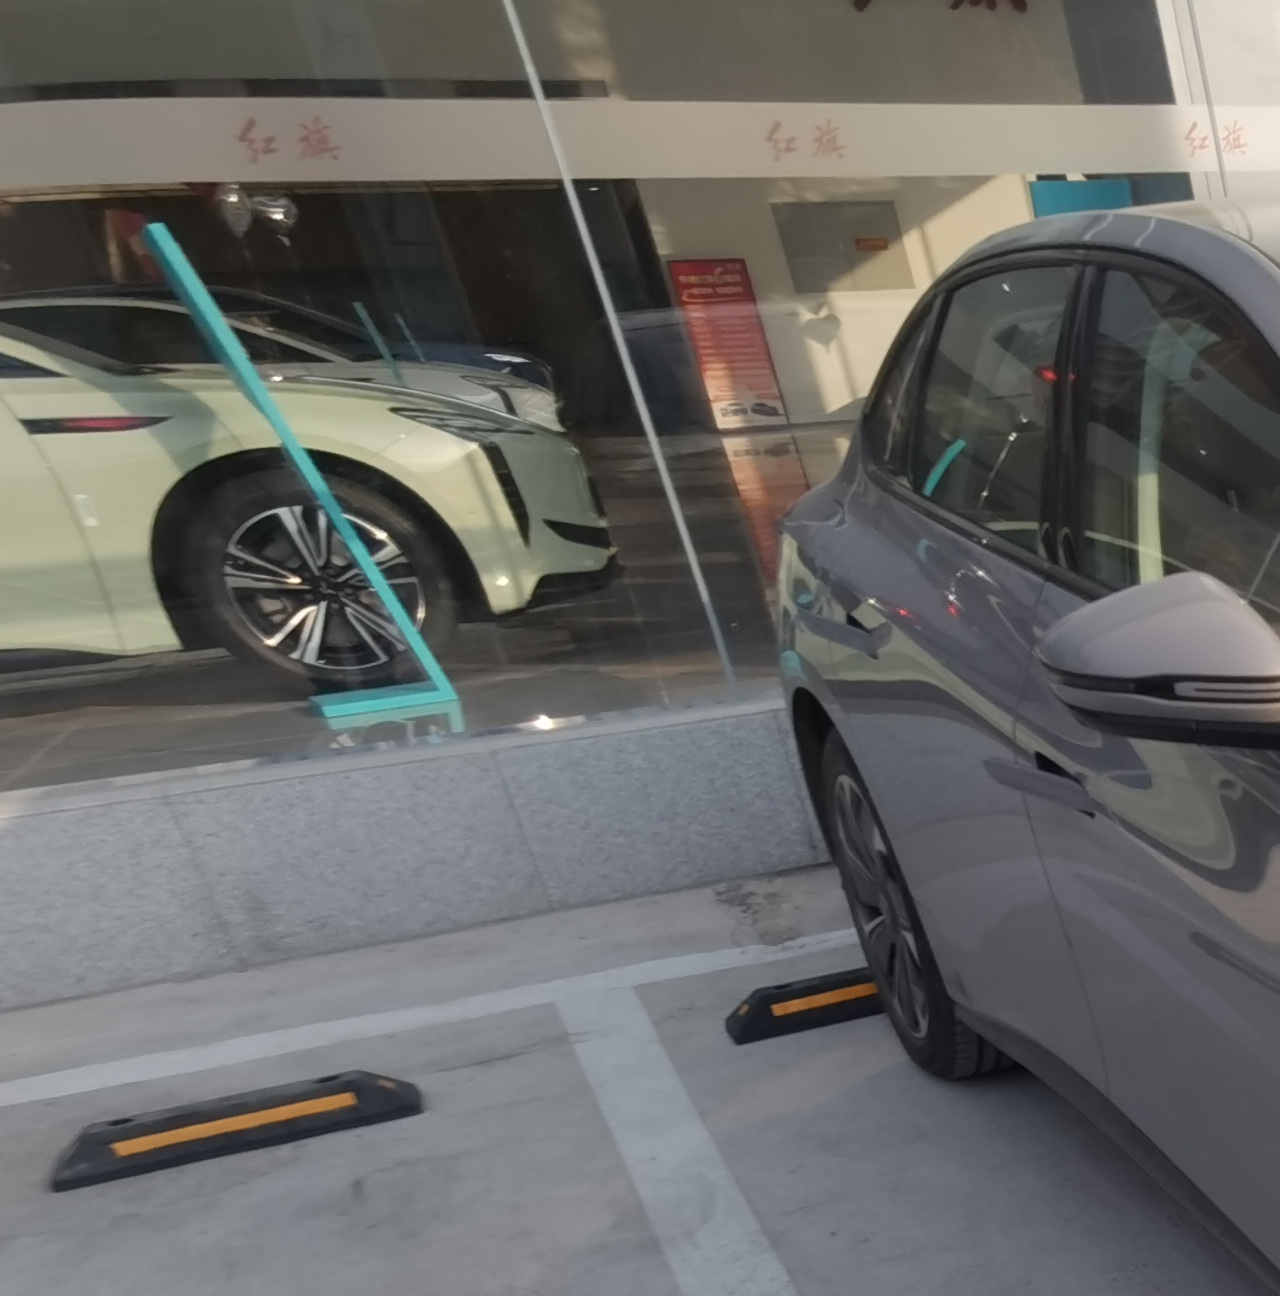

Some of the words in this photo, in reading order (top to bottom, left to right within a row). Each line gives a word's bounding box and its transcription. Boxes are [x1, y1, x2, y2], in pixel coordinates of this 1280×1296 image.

[237, 115, 341, 164] 红旗
[765, 119, 847, 161] 红旗
[1185, 119, 1248, 158] 红旗
